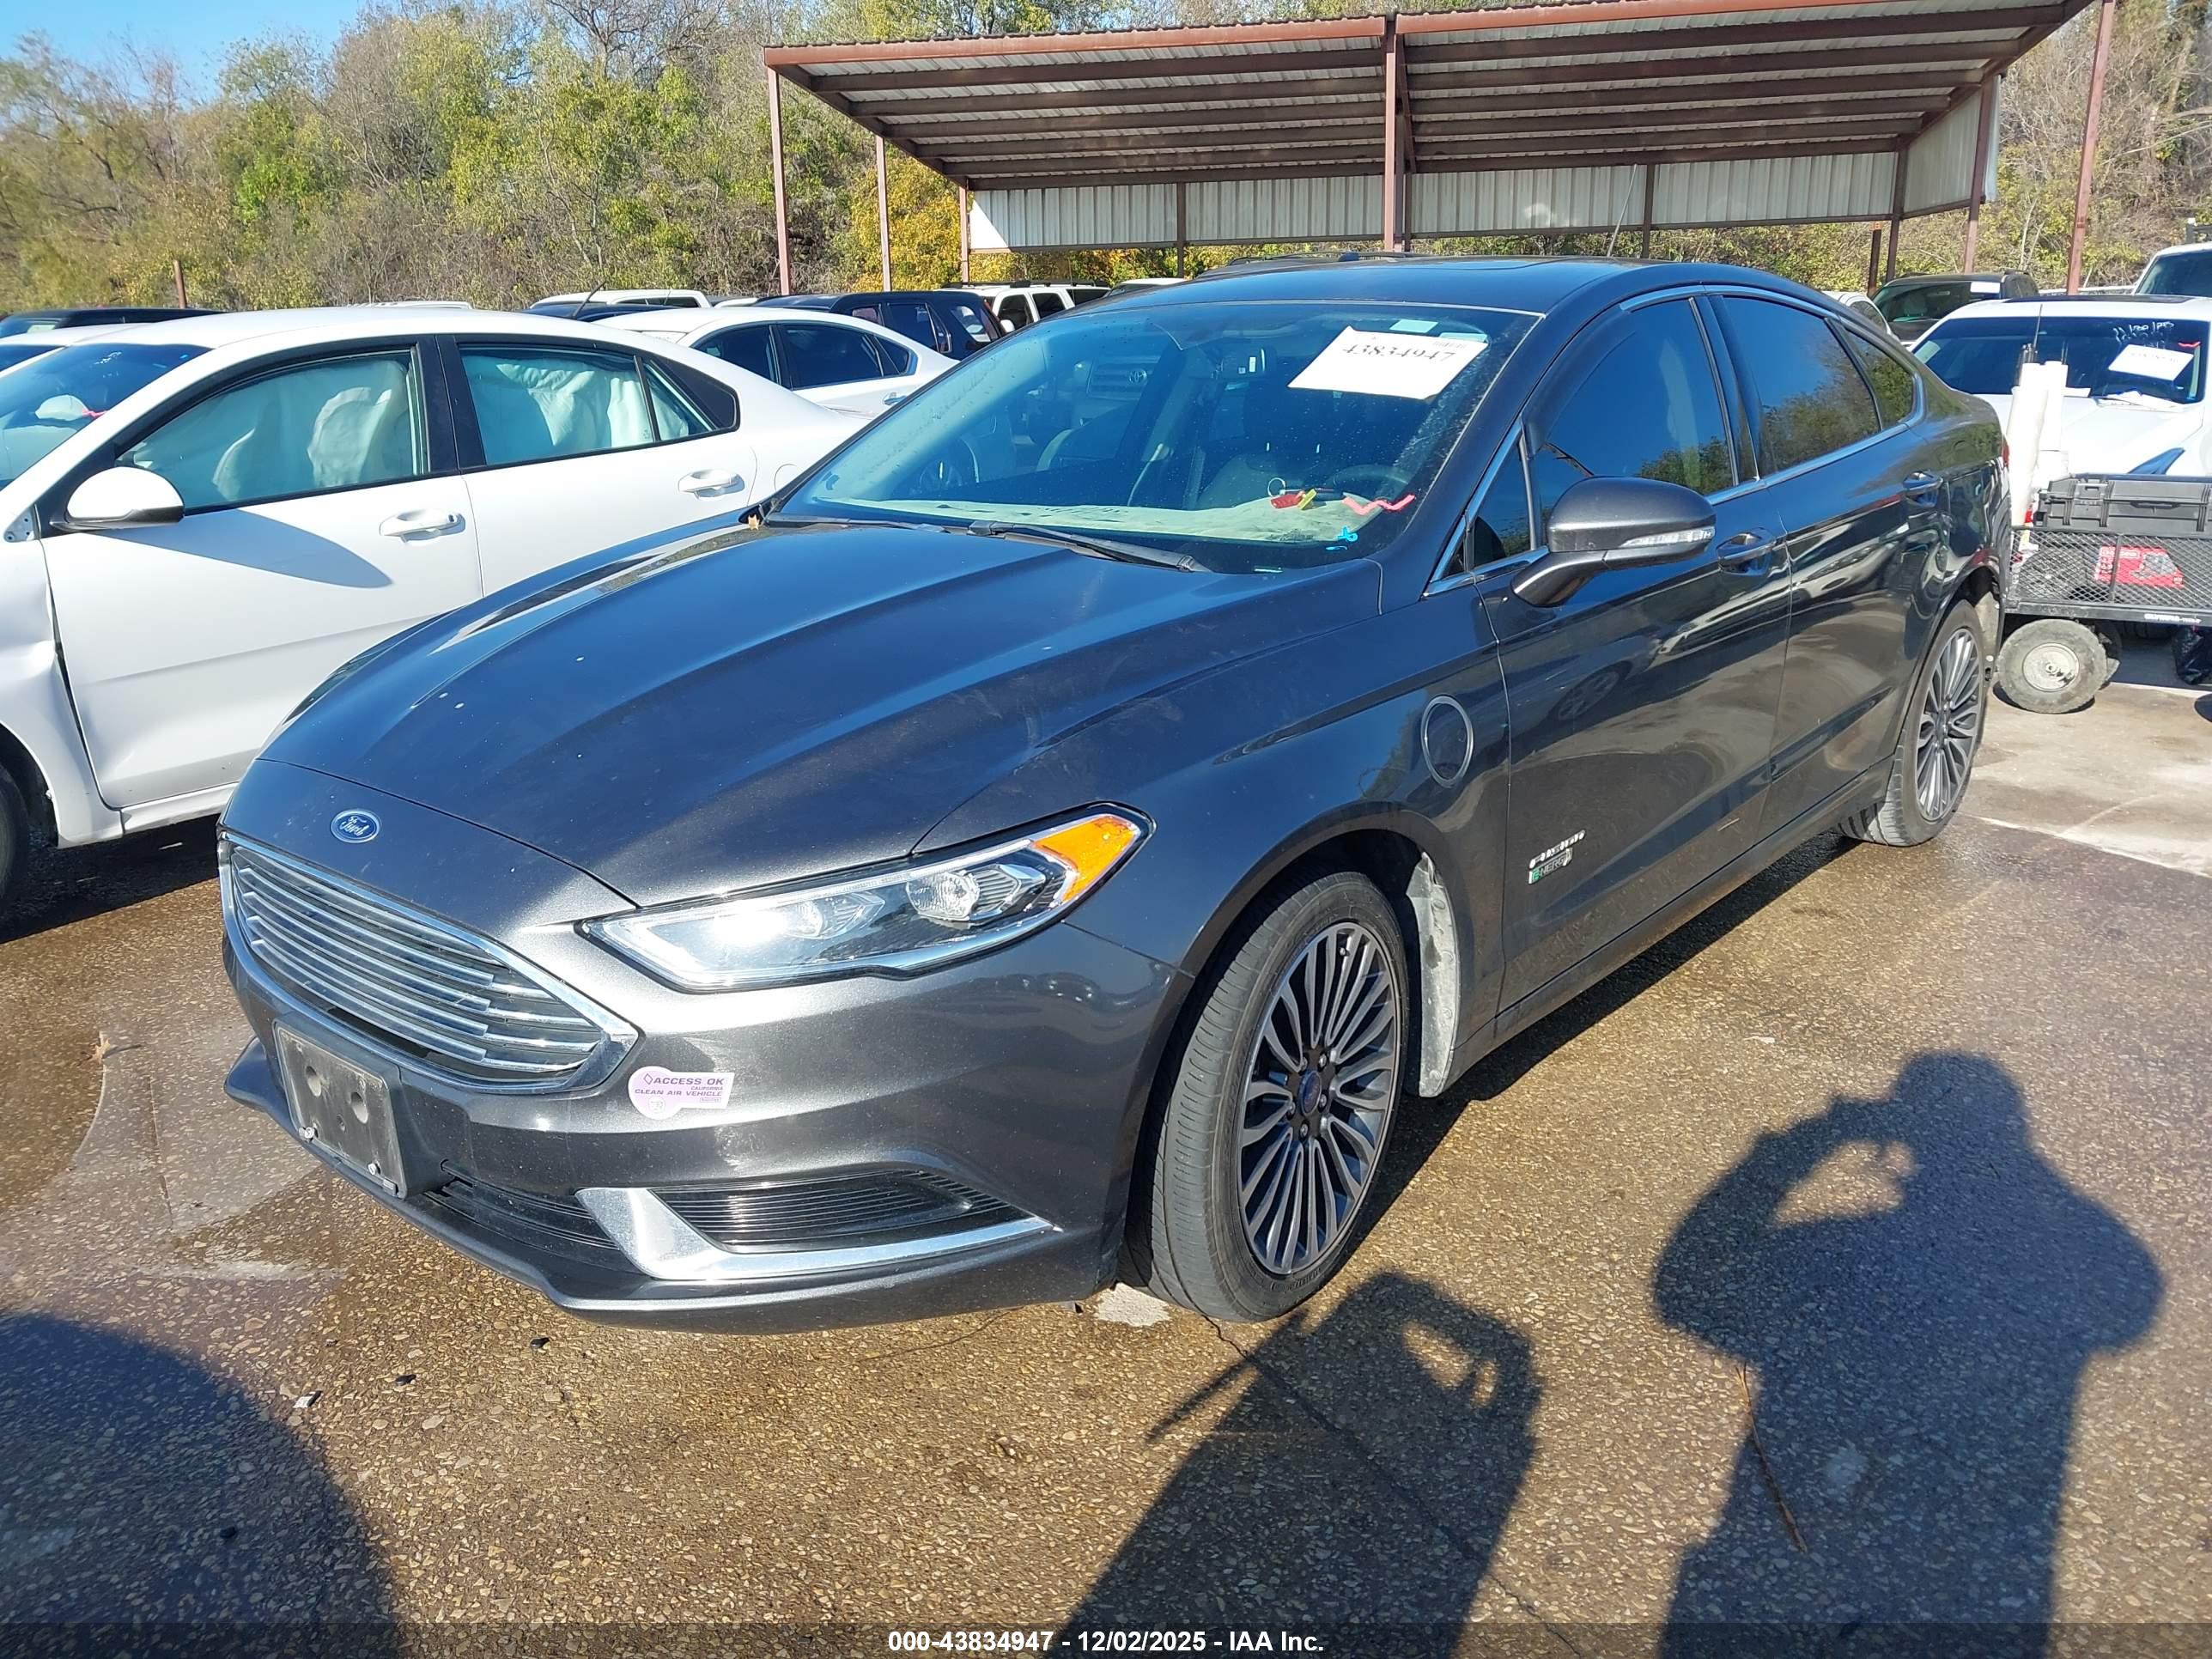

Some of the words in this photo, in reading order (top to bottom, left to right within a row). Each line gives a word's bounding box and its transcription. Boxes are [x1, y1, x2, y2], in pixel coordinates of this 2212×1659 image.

[1342, 343, 1456, 362] 43834947
[339, 816, 369, 836] Ford
[653, 1077, 702, 1085] ACCESS
